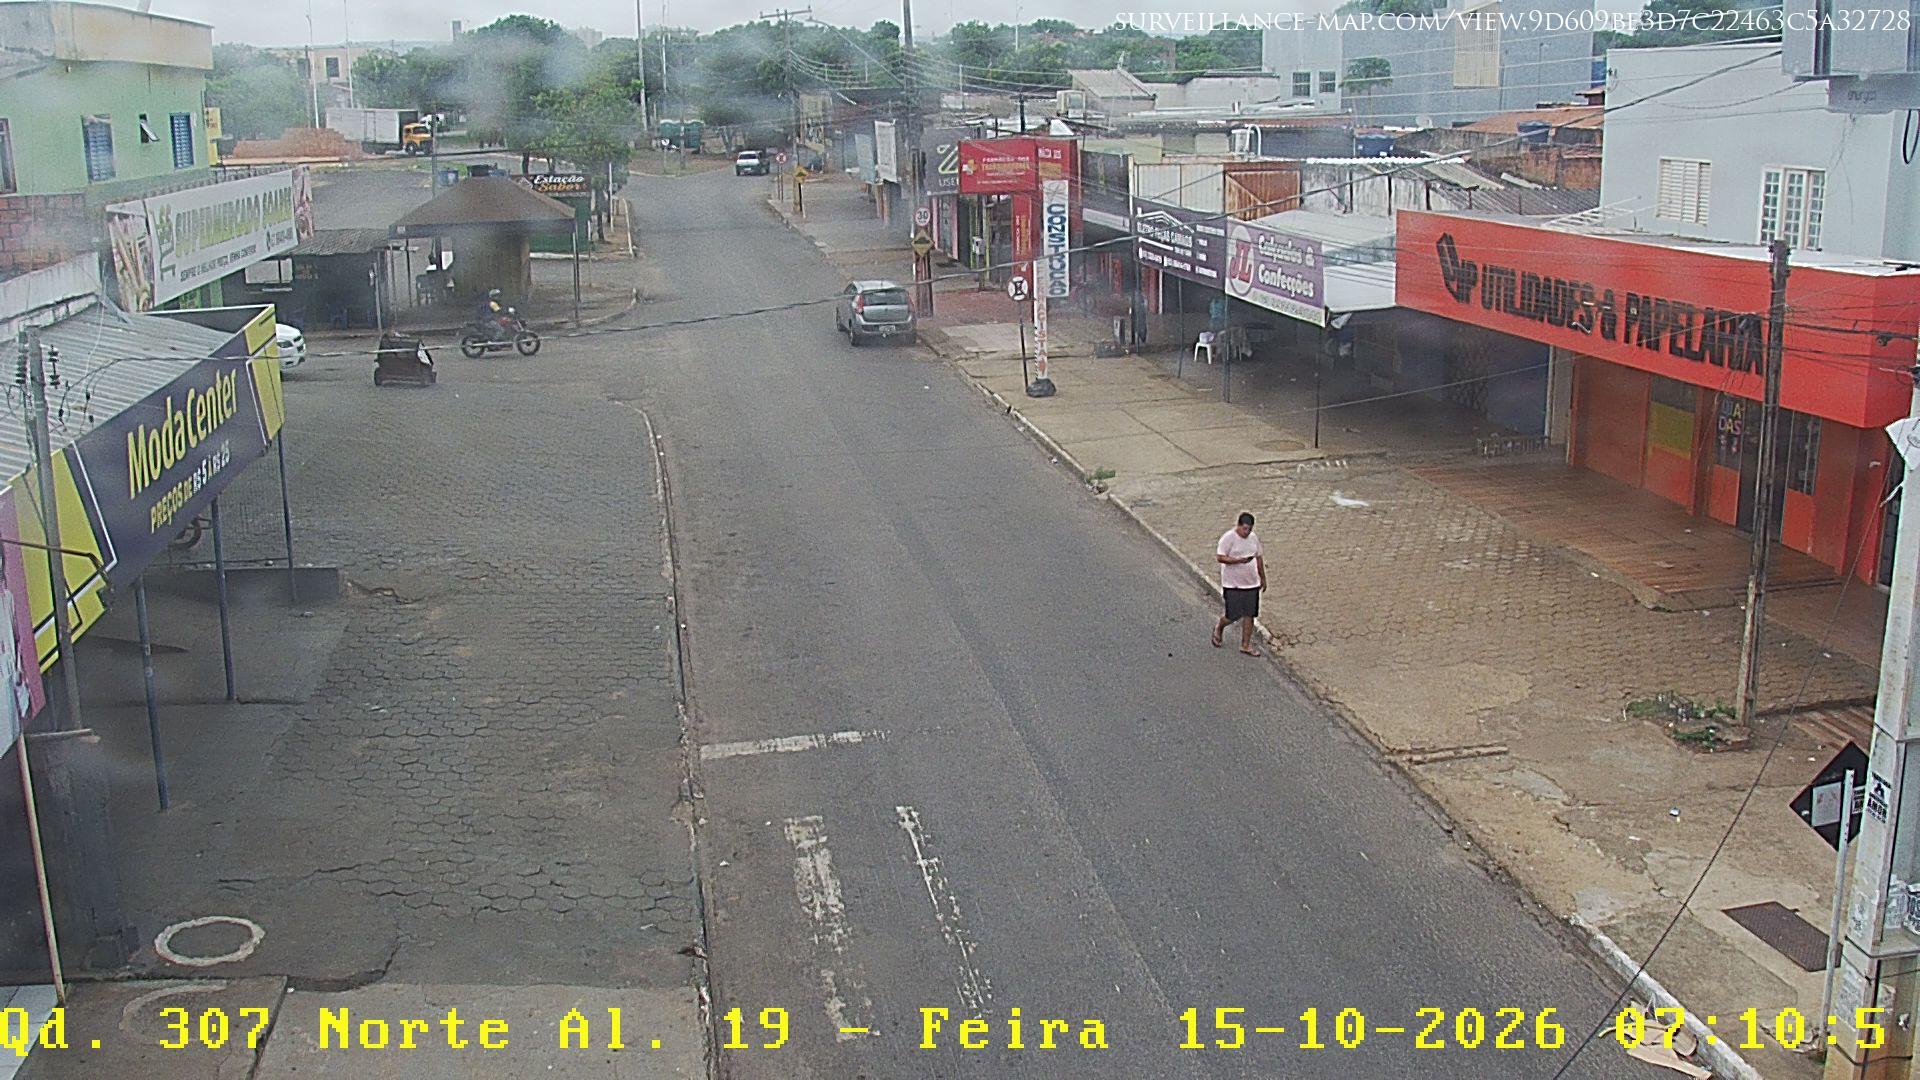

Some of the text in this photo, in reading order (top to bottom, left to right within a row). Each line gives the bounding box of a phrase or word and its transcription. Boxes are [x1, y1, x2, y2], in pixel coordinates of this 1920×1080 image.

[533, 174, 584, 184] Estação
[917, 210, 929, 220] 30
[1258, 234, 1315, 267] Calçados &
[1258, 263, 1314, 298] Confecções
[1481, 262, 1596, 335] UTILIDADES
[1624, 292, 1764, 376] PAPELARIA
[1718, 416, 1742, 435] DAS
[150, 481, 183, 534] PREÇOS
[183, 475, 193, 503] DE
[202, 458, 208, 486] 5
